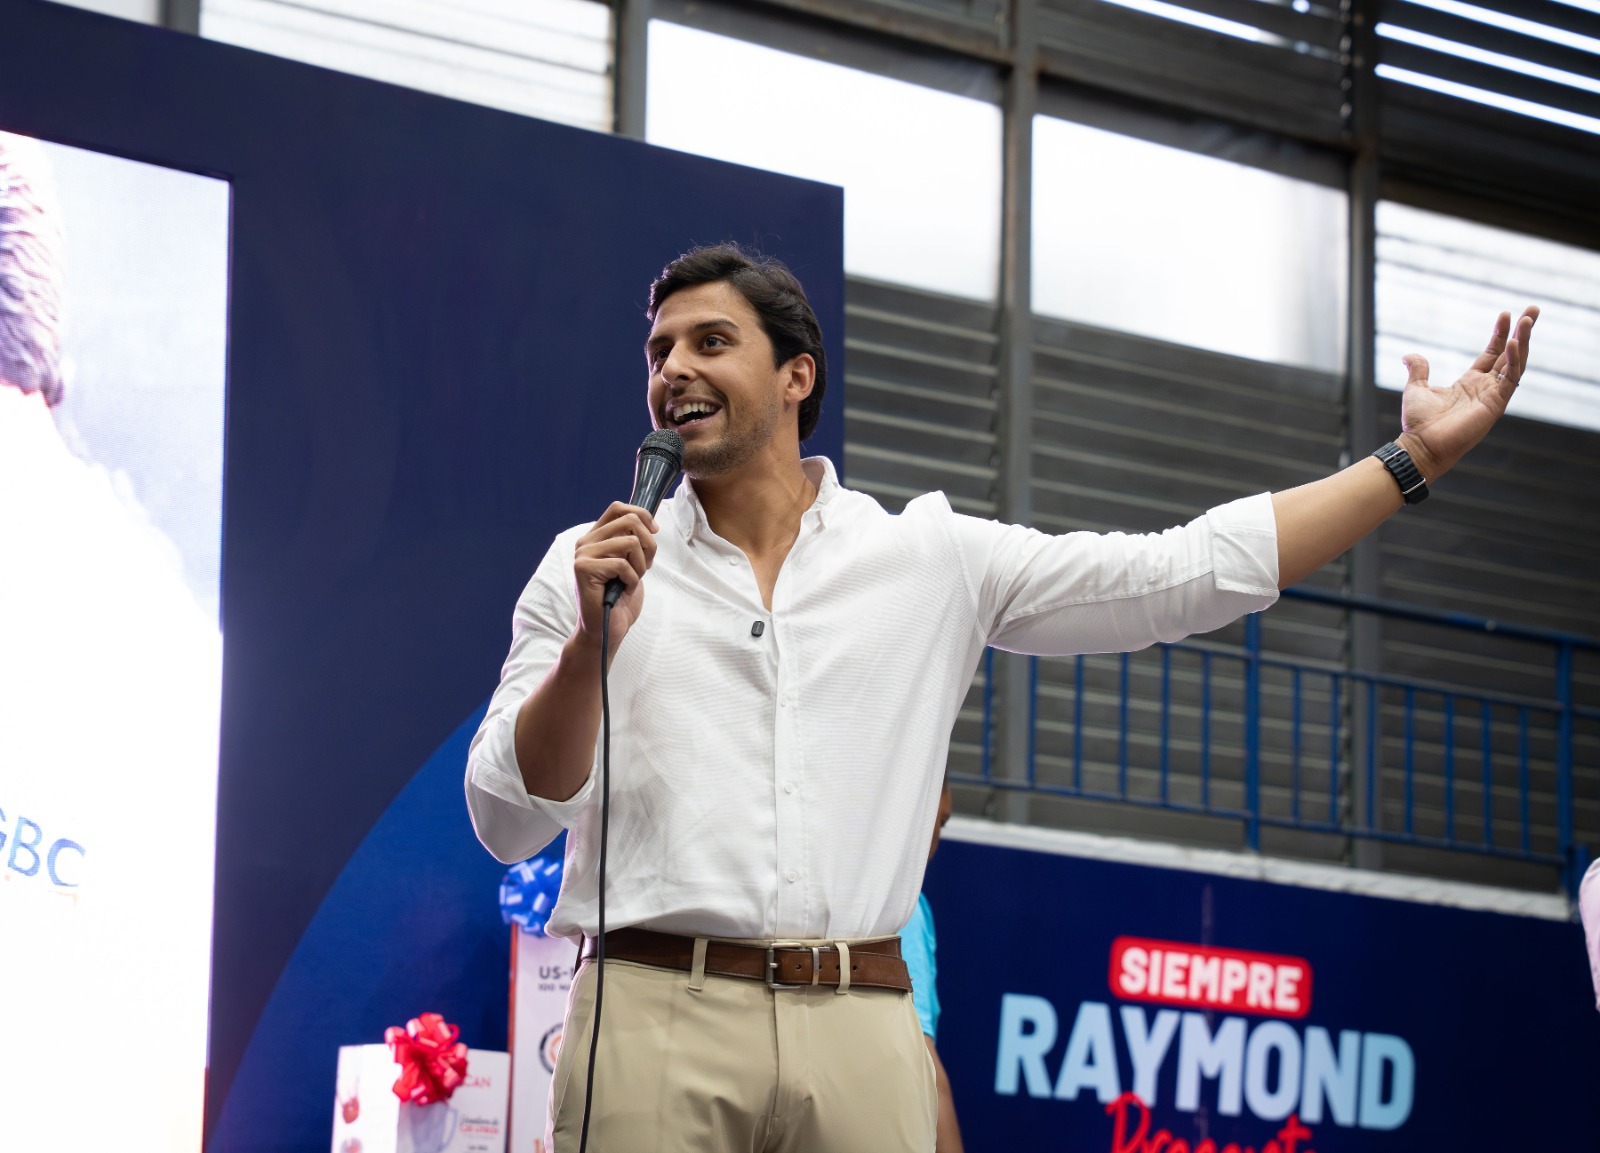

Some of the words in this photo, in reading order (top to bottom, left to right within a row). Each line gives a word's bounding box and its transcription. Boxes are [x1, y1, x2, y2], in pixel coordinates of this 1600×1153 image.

[0, 808, 86, 887] BC
[1119, 947, 1303, 1012] SIEMPRE
[994, 993, 1415, 1130] RAYMOND
